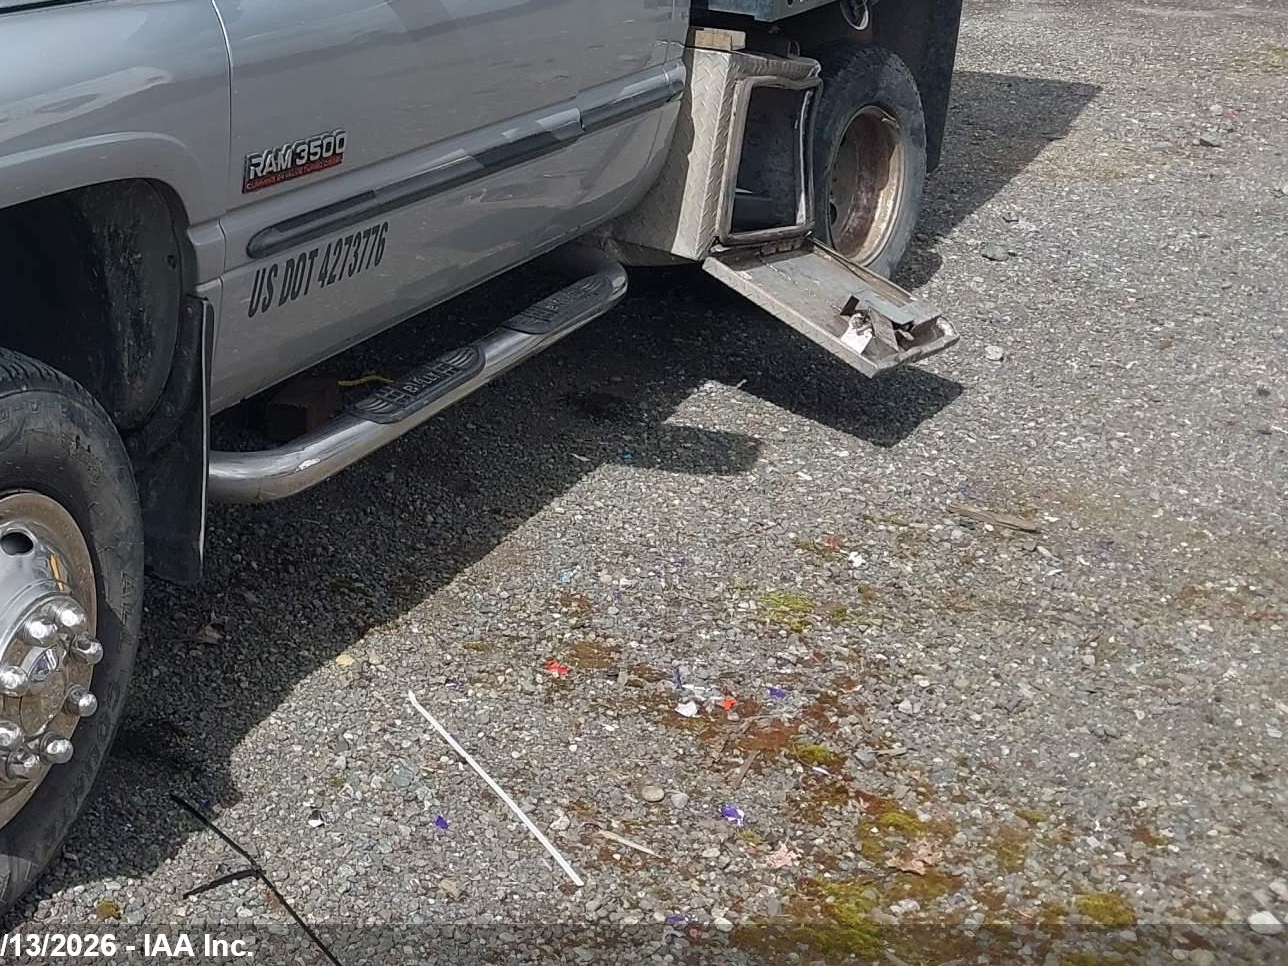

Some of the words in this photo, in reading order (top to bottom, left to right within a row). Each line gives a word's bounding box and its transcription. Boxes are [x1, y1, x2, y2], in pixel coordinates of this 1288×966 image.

[247, 143, 293, 180] RAM
[292, 128, 348, 166] 3500
[247, 263, 279, 318] US
[278, 247, 319, 307] DOT
[317, 221, 389, 289] 4273776
